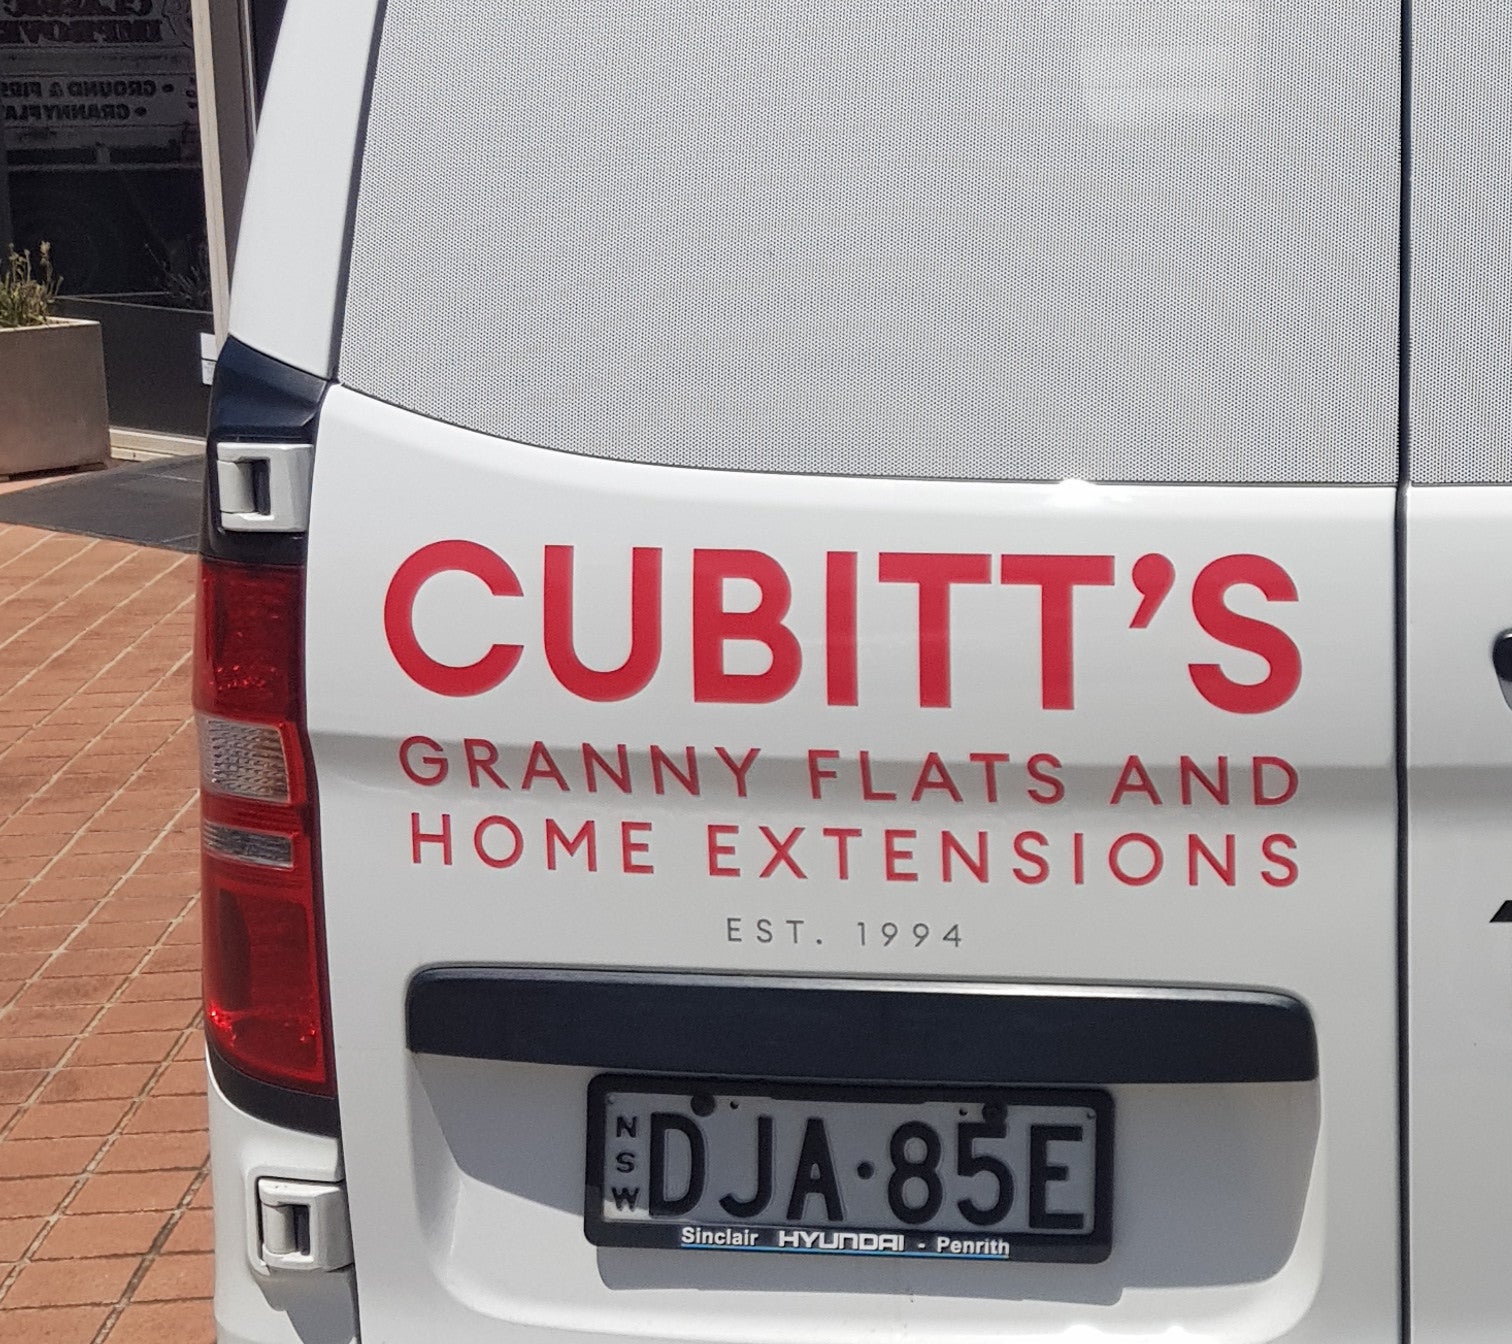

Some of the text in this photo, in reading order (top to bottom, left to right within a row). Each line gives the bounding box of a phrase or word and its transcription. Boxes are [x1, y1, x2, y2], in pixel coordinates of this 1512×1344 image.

[384, 540, 1302, 714] CUBITT'S
[399, 734, 1300, 807] GRANNY FLATS AND
[410, 812, 1299, 888] HOME EXTENSIONS
[726, 917, 964, 948] EST. 1994
[681, 1226, 760, 1247] Sinclair
[777, 1229, 905, 1252] HYUNDAI
[936, 1235, 1011, 1256] Penrith
